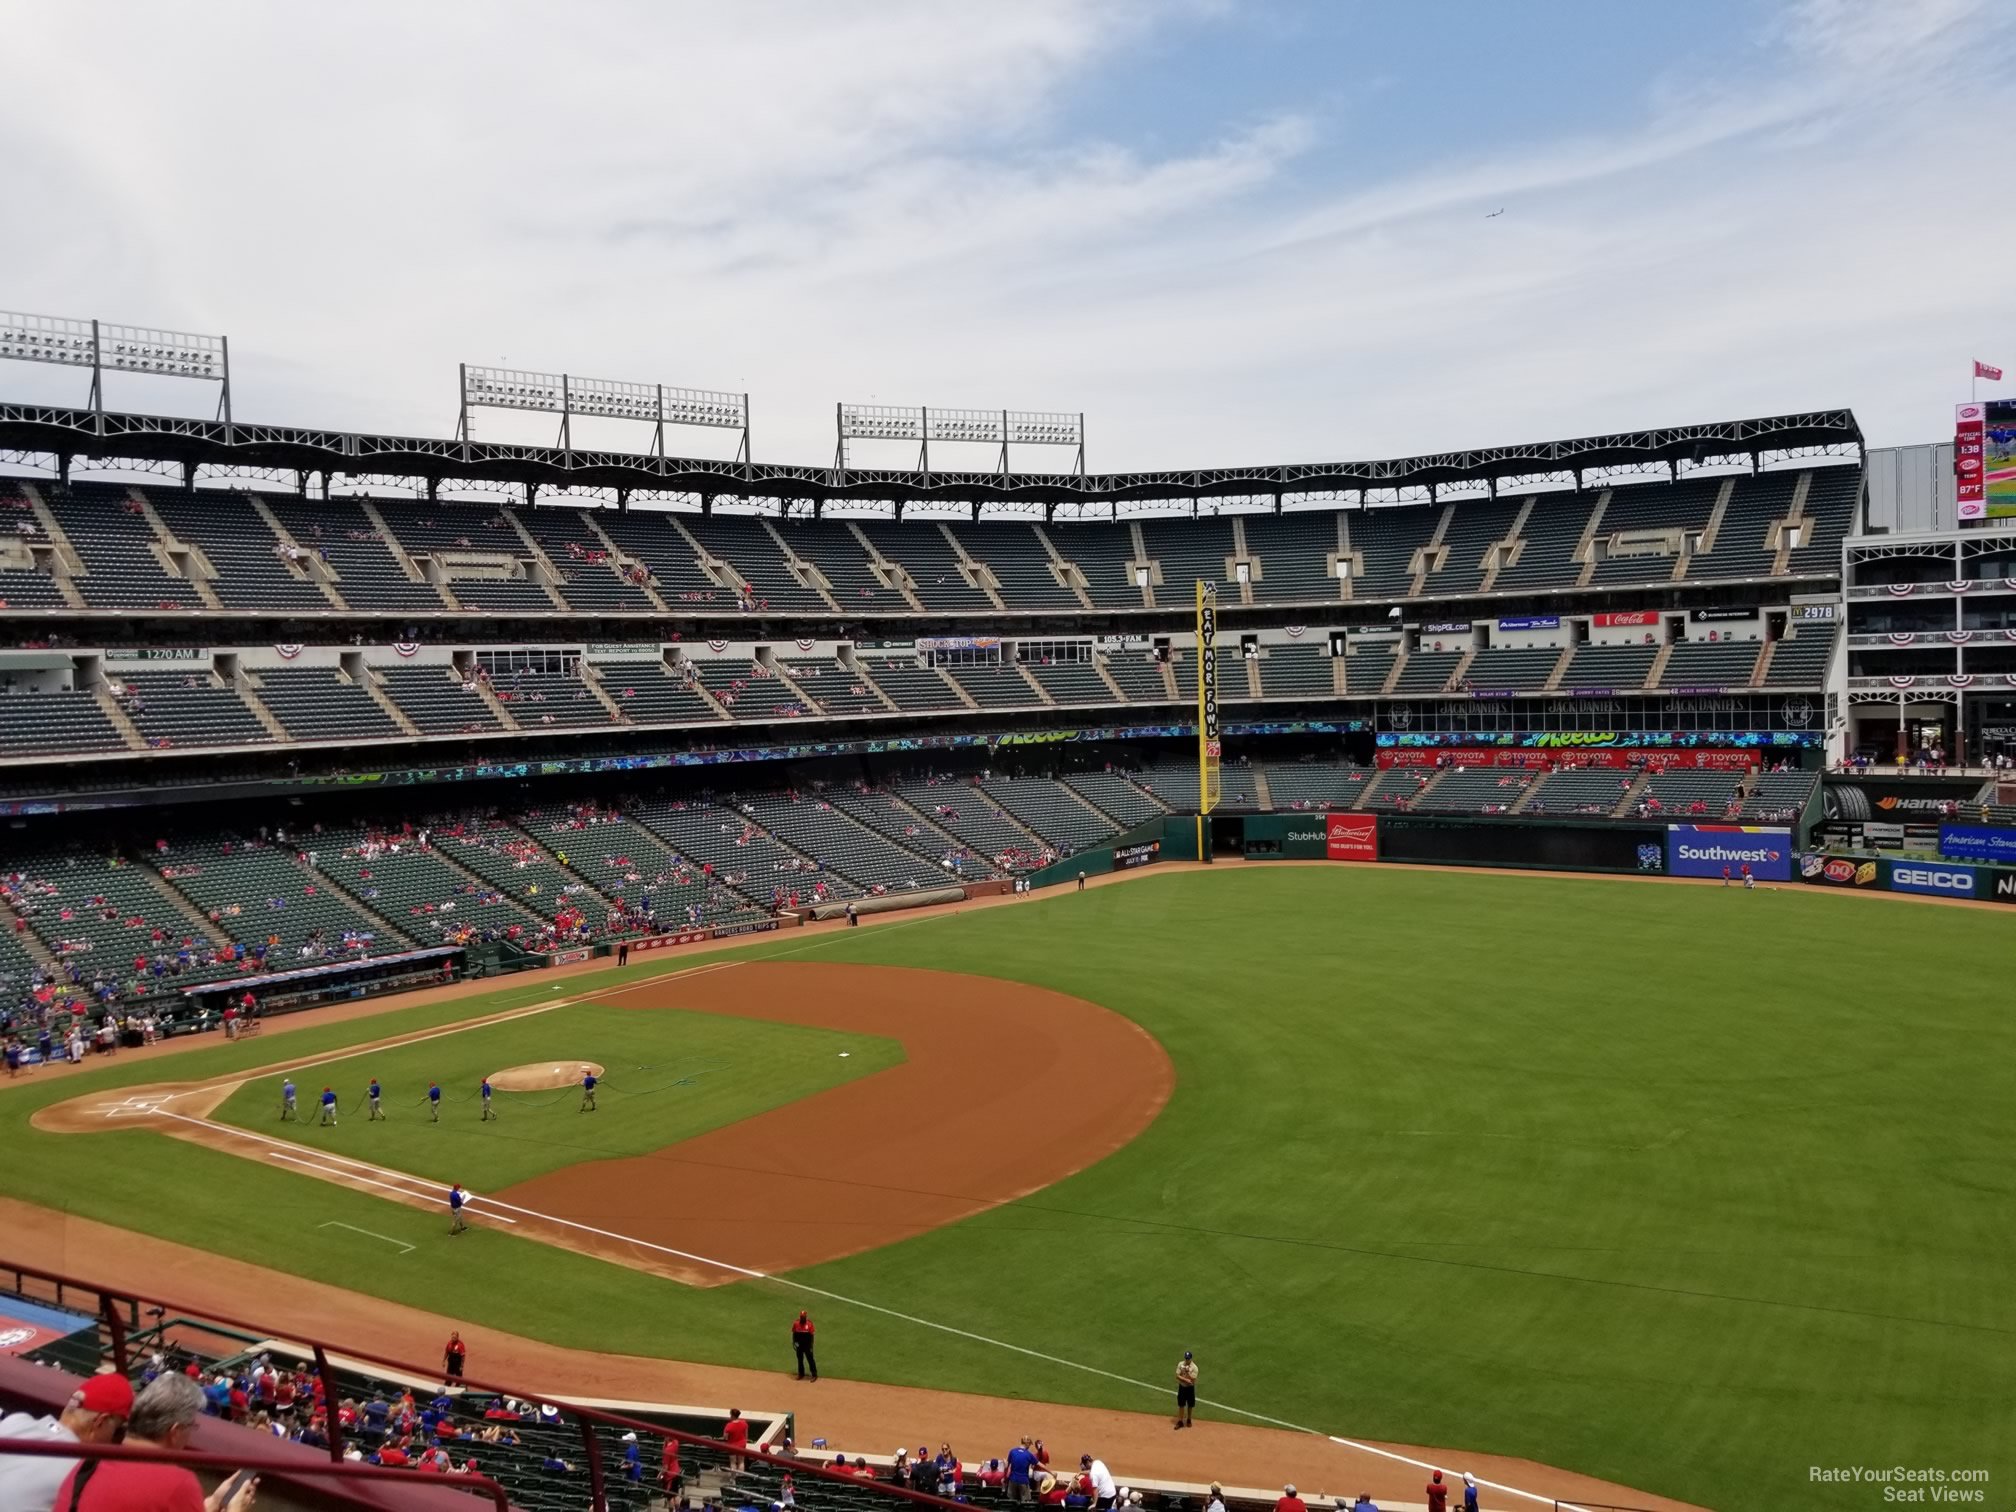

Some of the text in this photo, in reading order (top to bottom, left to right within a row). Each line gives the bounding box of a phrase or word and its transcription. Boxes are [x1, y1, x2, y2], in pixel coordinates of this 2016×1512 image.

[1961, 445, 1980, 454] 1:38
[1804, 607, 1833, 618] 2978
[1203, 610, 1212, 645] EAT
[1427, 623, 1469, 633] ShipPGL.com
[919, 638, 949, 649] SHOCK
[954, 639, 971, 649] TOP
[146, 650, 173, 659] 1270
[175, 649, 194, 659] AM
[1204, 649, 1214, 684] MOR
[1440, 701, 1466, 714] JACK
[1548, 700, 1576, 713] JACK
[1665, 698, 1695, 712] JACK
[1206, 689, 1217, 736] FOWL
[1711, 753, 1751, 761] TOYOTA
[1288, 831, 1326, 841] StubHub
[1333, 827, 1370, 838] Budweiser
[1943, 833, 1986, 846] American
[1678, 845, 1767, 862] Southwest
[1830, 864, 1851, 877] DQ
[1893, 868, 1973, 890] GEICO
